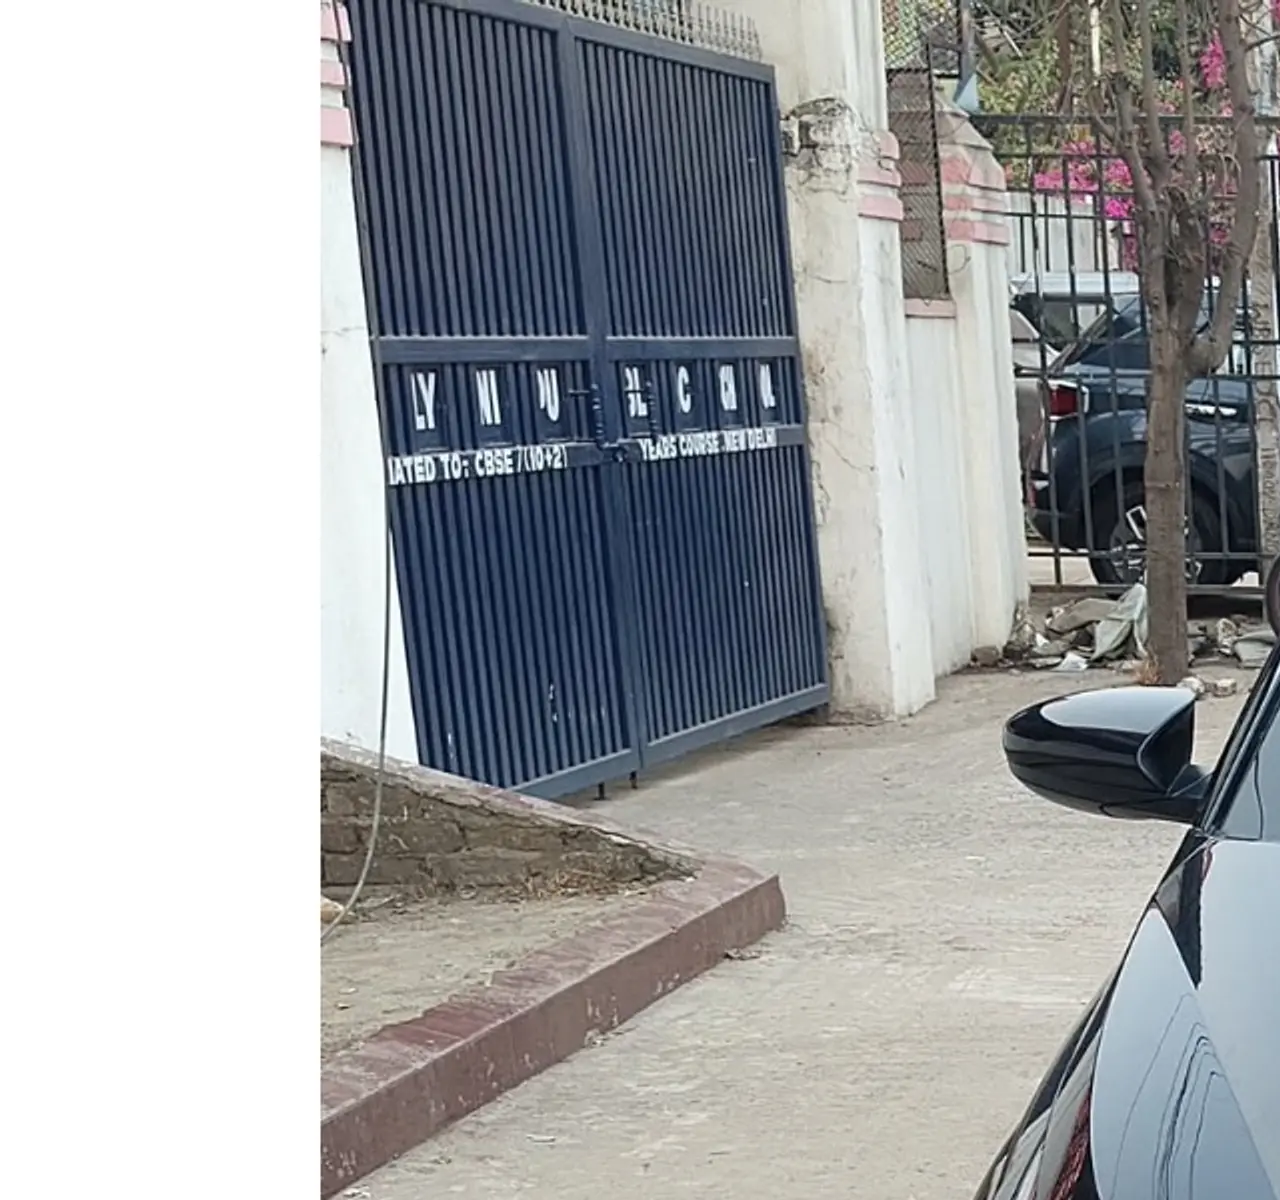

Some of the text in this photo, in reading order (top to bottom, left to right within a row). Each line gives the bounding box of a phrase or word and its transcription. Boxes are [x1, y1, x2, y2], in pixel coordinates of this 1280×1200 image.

[638, 432, 677, 461] YEARS
[678, 430, 720, 457] COURSE
[475, 448, 514, 477] CBSE
